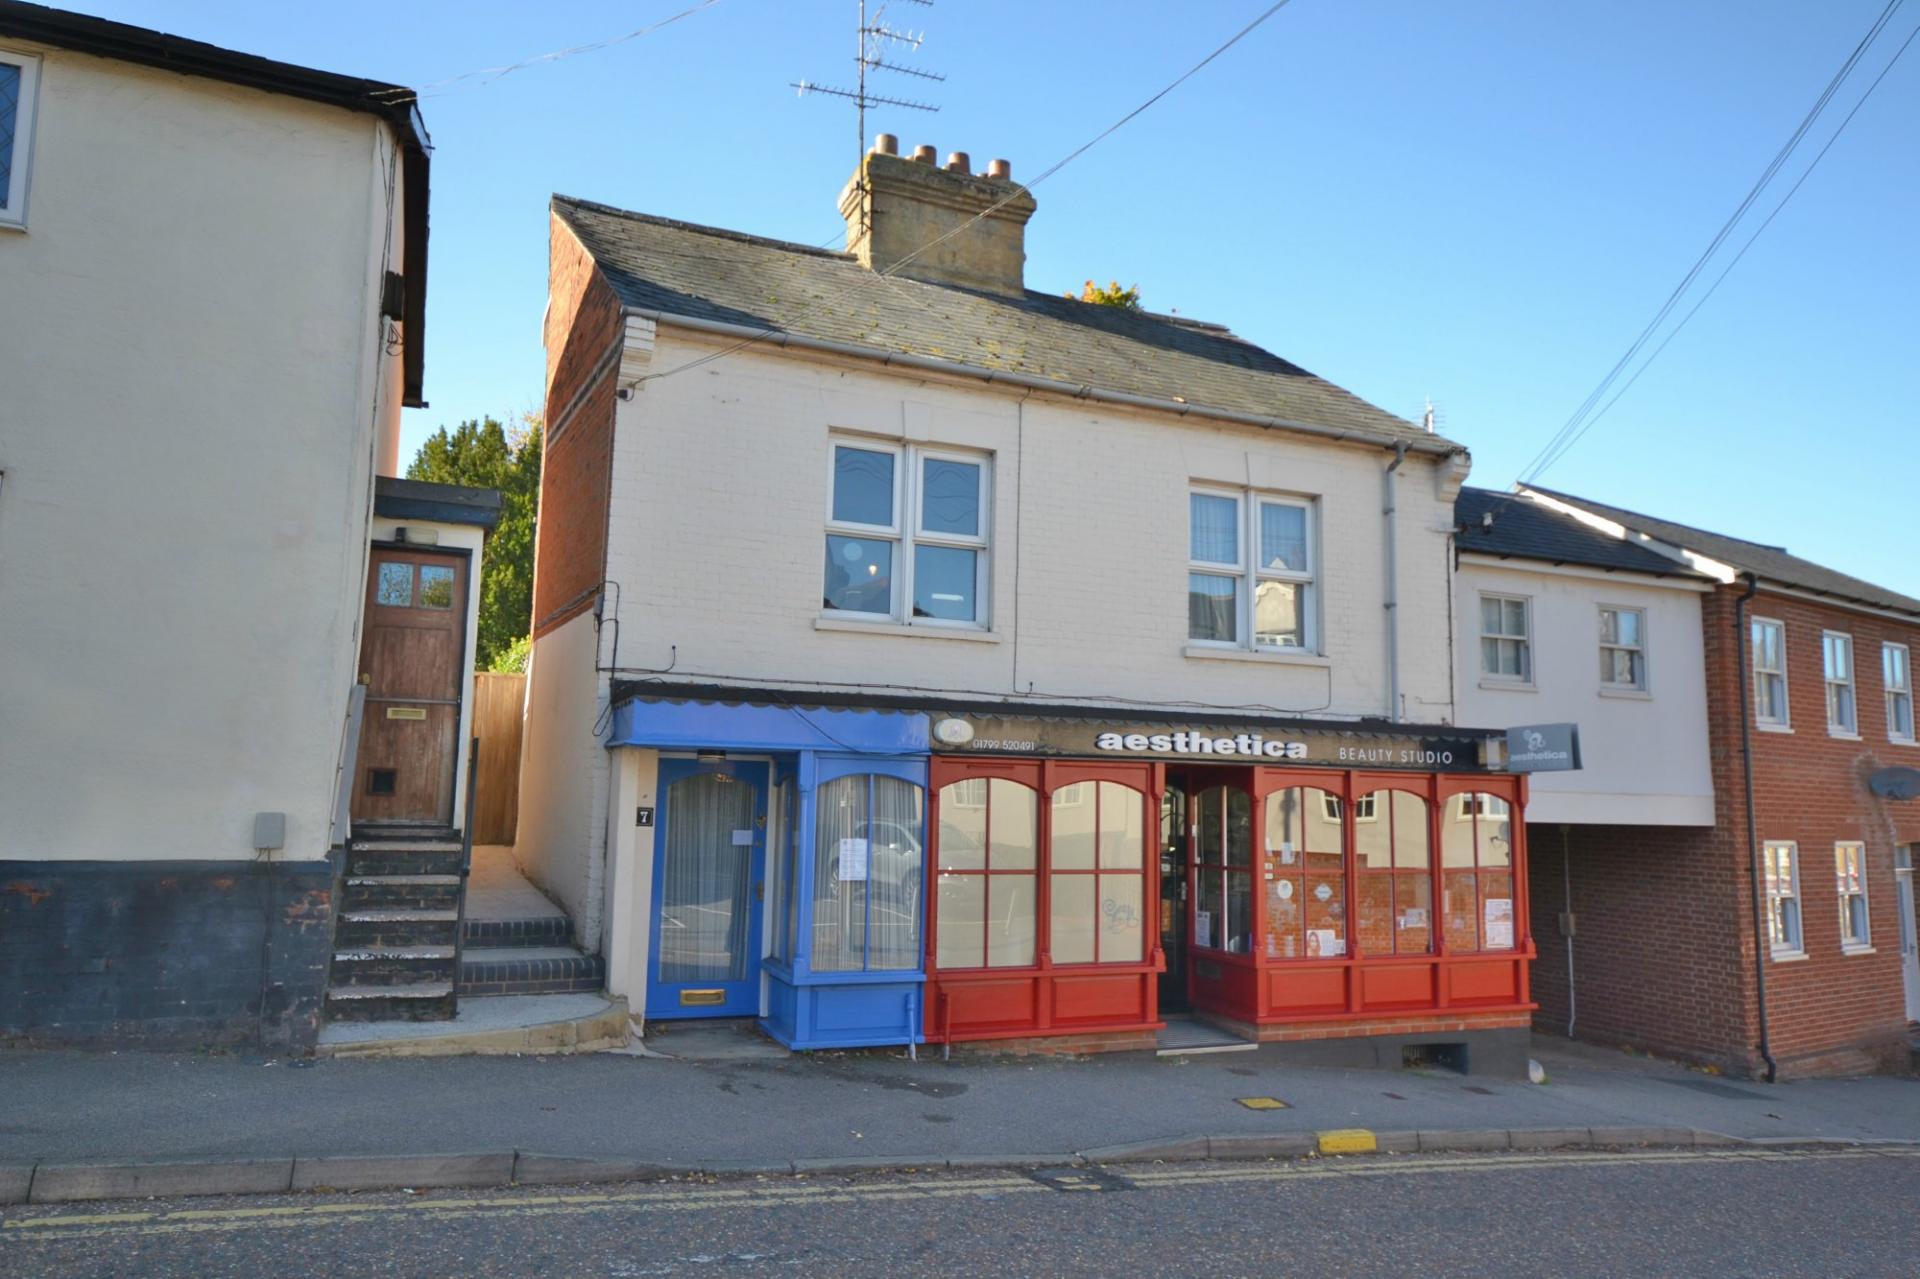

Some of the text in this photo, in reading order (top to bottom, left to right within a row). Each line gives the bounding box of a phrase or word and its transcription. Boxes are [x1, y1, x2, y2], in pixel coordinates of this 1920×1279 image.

[973, 739, 1035, 751] 01799 520491
[1096, 731, 1307, 759] aesthetica
[1339, 747, 1453, 764] BEAUTY STUDIO
[640, 811, 649, 824] 7
